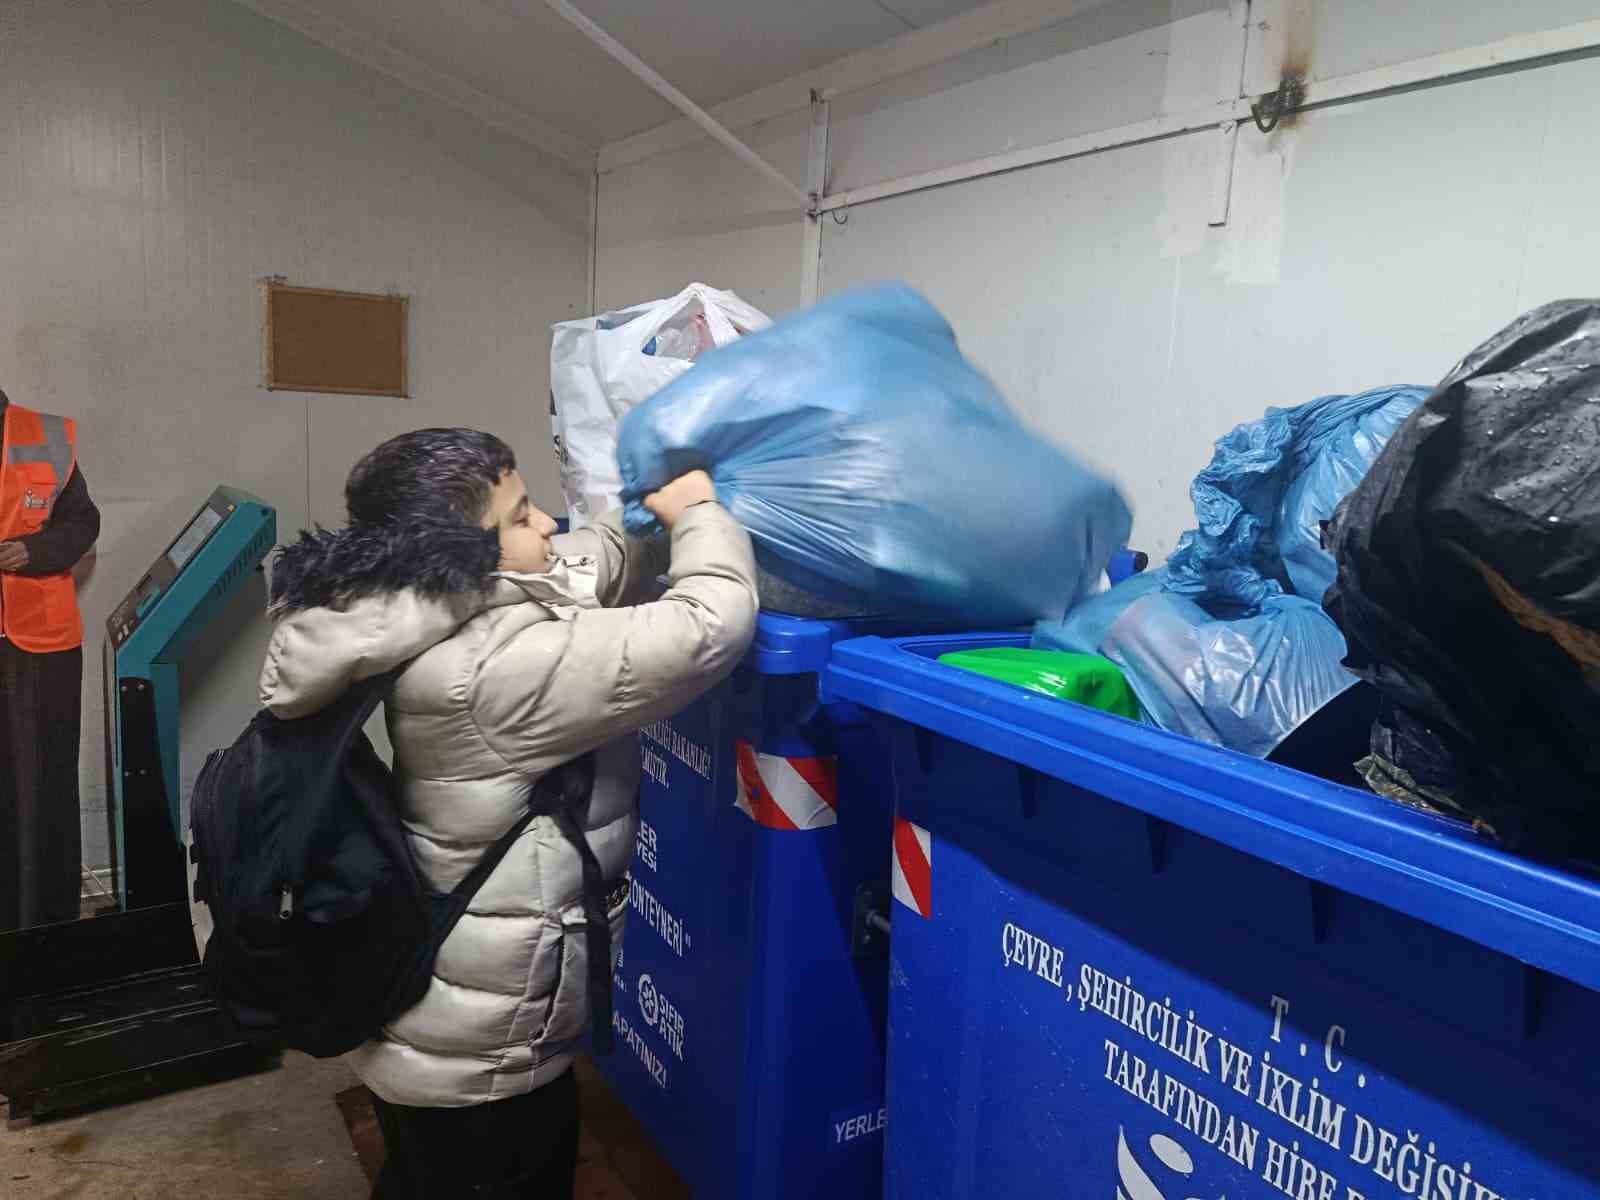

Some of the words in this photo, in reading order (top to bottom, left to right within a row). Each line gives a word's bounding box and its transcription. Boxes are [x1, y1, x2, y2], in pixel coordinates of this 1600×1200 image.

[658, 1016, 685, 1063] ATIK
[659, 992, 685, 1040] SIFIR
[1076, 962, 1213, 1075] ŞEHİRCİLİK
[1217, 1037, 1253, 1097] VE
[1103, 1039, 1260, 1171] TARAFINDAN
